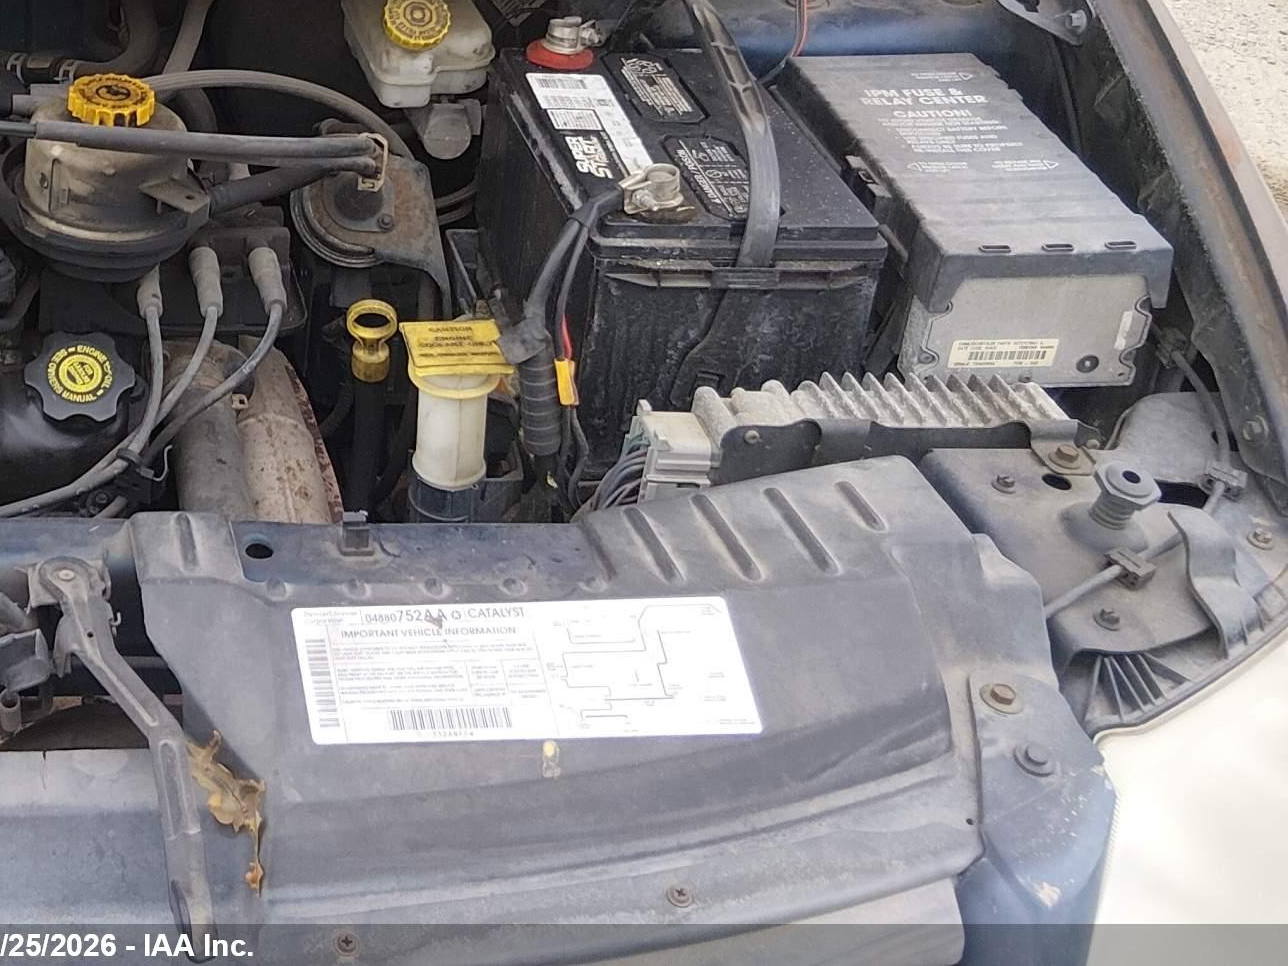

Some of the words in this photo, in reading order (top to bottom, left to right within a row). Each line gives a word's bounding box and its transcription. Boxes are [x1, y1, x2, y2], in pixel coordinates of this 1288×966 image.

[901, 88, 946, 97] FUSE
[859, 97, 914, 106] RELAY
[918, 95, 989, 105] CENTER
[77, 345, 108, 364] ENGINE
[61, 390, 98, 403] MANUAL
[467, 606, 526, 619] CATALYST
[341, 628, 400, 638] IMPORTANT
[401, 627, 442, 637] VEHICLE
[444, 626, 517, 636] INFORMATION
